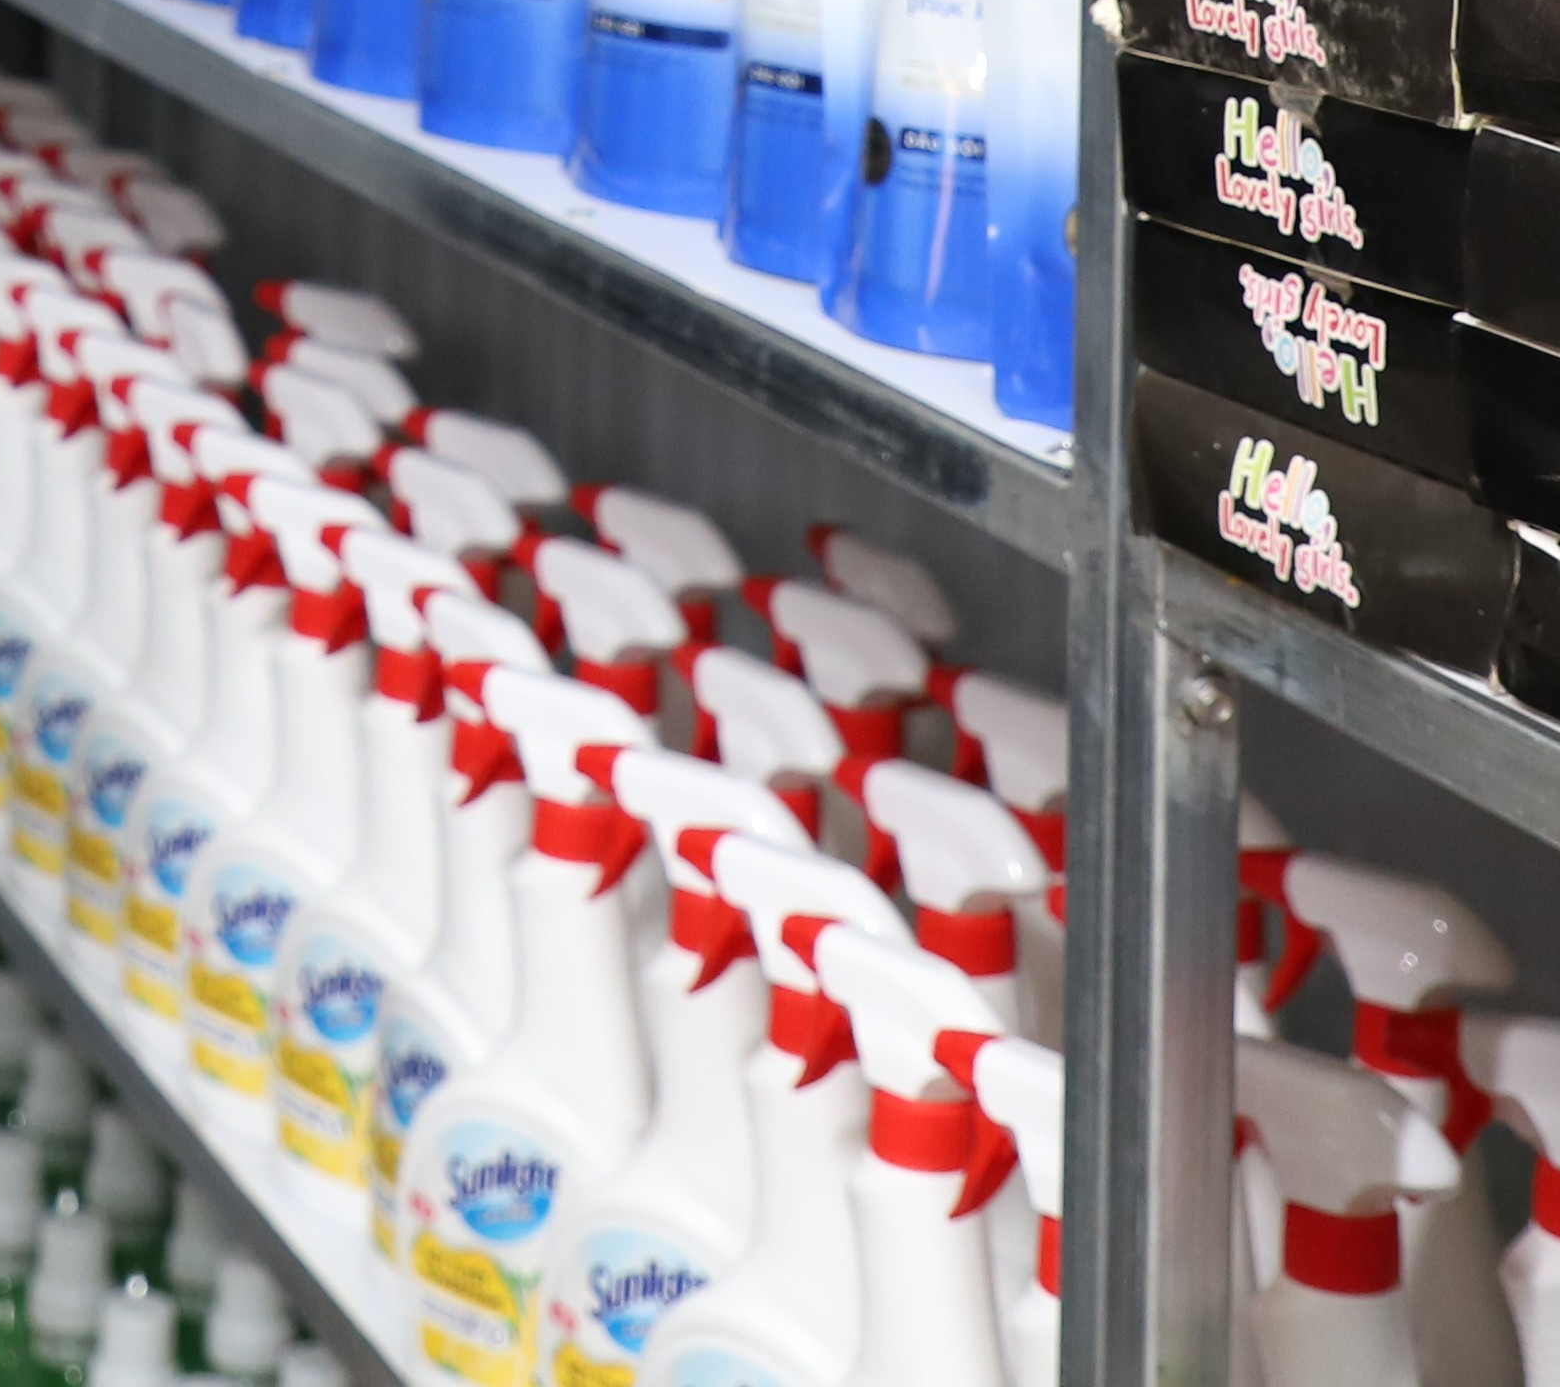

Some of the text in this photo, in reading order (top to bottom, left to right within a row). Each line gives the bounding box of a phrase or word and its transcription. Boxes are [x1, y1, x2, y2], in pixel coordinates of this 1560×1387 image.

[1222, 97, 1335, 195] Hello,
[1216, 153, 1363, 248] Lovely girls.
[1237, 263, 1386, 369] Lovely girls.
[1261, 317, 1379, 426] Hello,
[1230, 437, 1336, 547] Hello,
[1218, 491, 1360, 607] Lovely girls.
